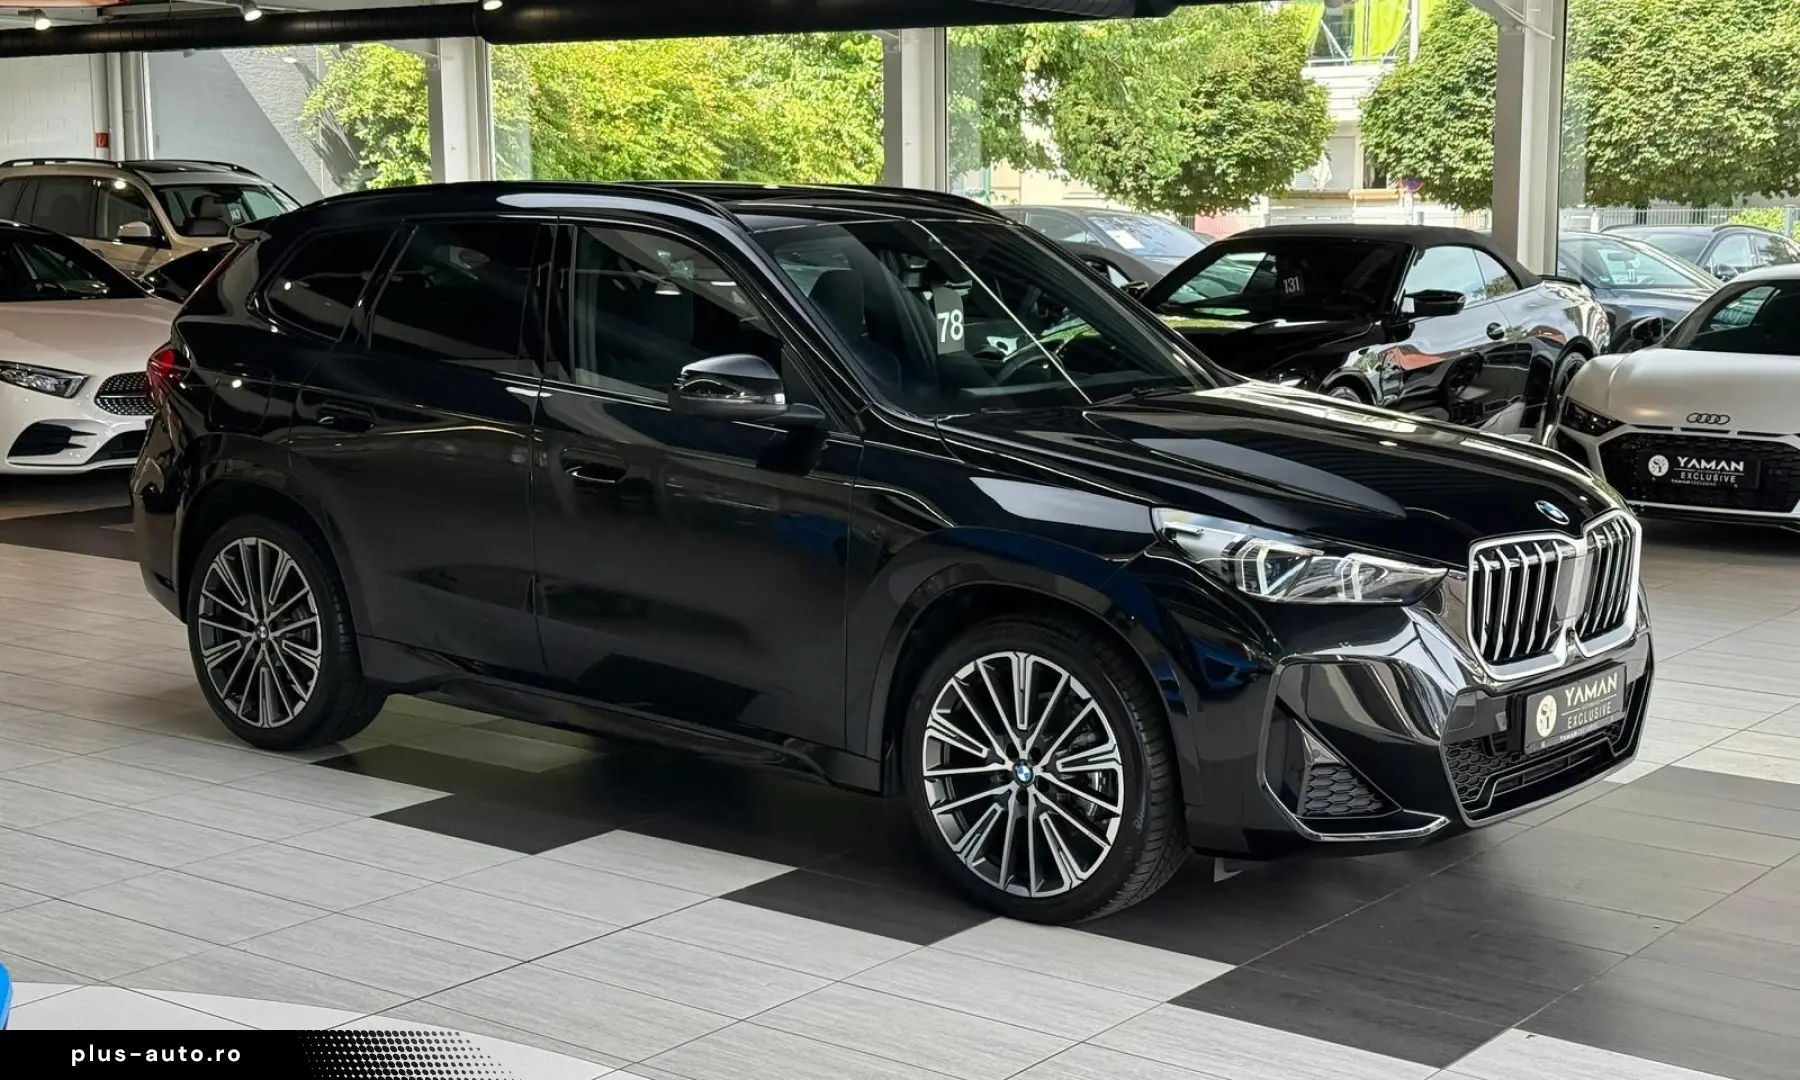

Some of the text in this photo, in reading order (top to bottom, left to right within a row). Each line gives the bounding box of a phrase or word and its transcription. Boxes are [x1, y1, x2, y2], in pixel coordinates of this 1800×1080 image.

[1283, 276, 1300, 294] 131
[937, 309, 964, 343] 78
[1677, 456, 1744, 472] YAMAN
[1681, 472, 1736, 483] EXCLUSIVE
[1564, 672, 1618, 707] YAMAN
[1567, 702, 1612, 729] EXCLUSIVE
